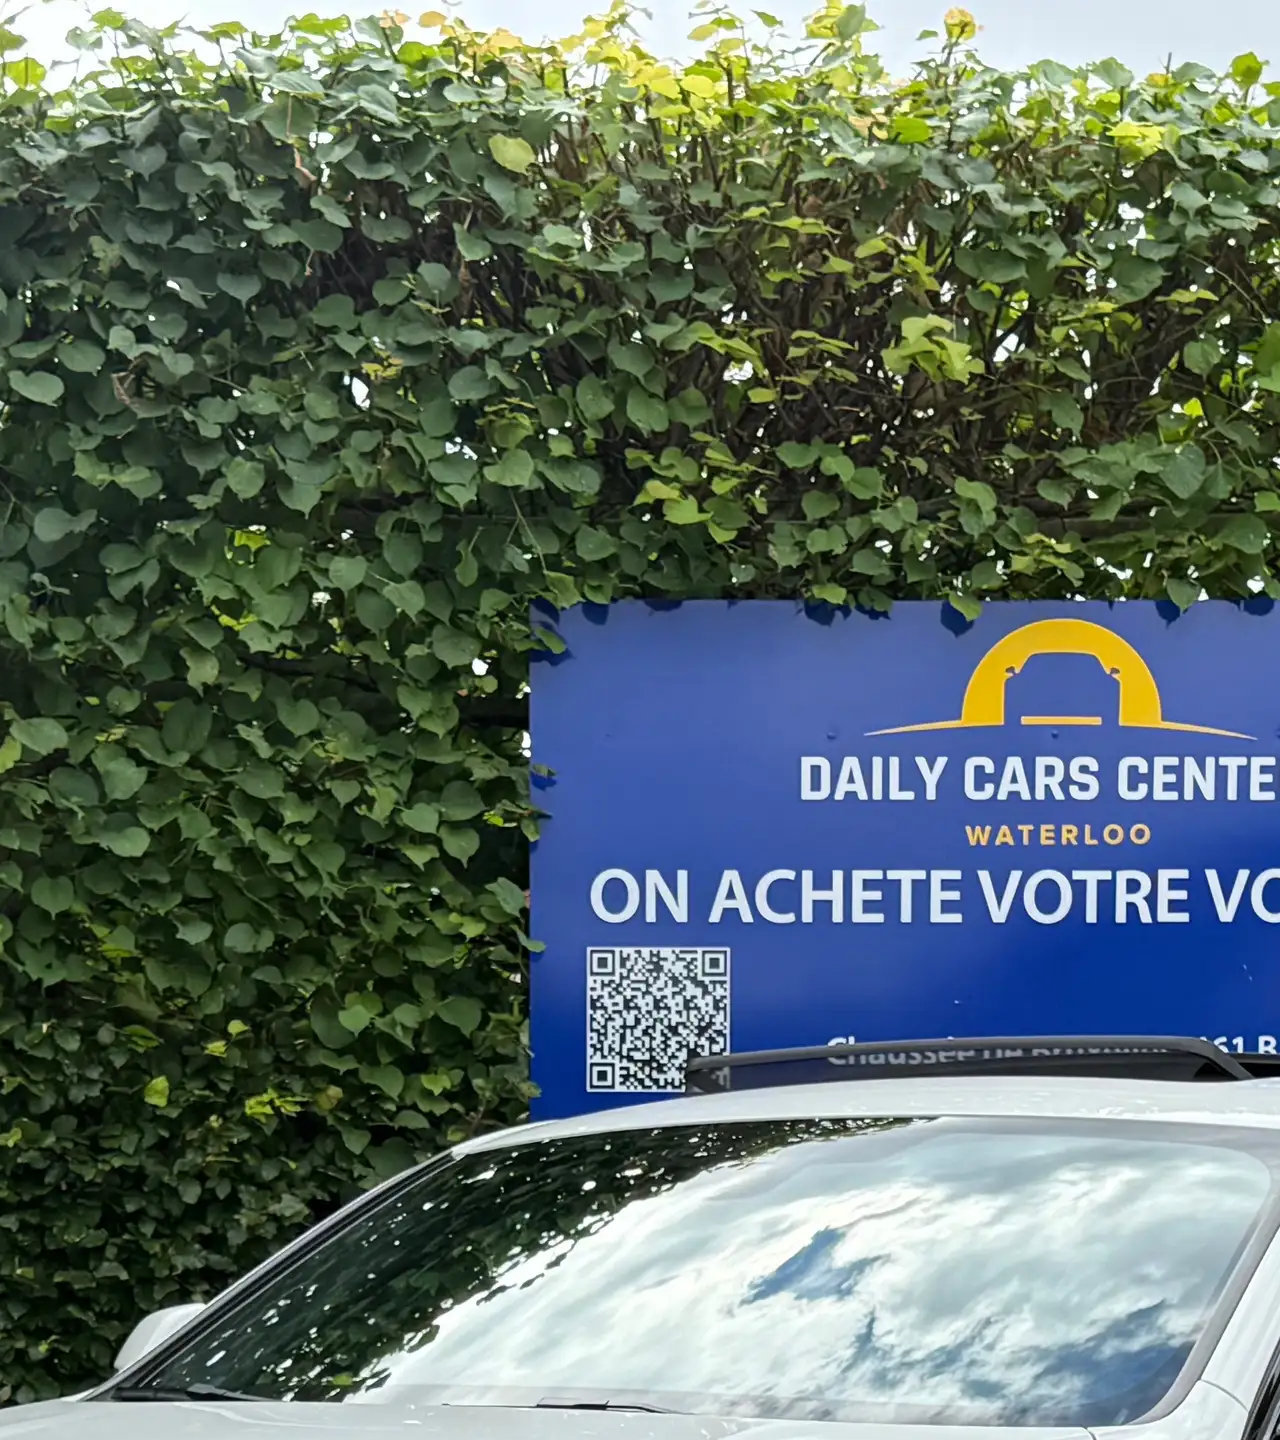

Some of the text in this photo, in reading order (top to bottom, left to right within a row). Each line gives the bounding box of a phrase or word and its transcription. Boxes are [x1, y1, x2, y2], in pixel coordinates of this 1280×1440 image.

[800, 756, 949, 801] DAILY
[964, 756, 1100, 801] CARS
[964, 823, 1151, 846] WATERLOO
[590, 868, 688, 924] ON
[708, 868, 963, 924] ACHETE
[976, 868, 1190, 925] VOTRE
[1200, 1036, 1244, 1054] 61
